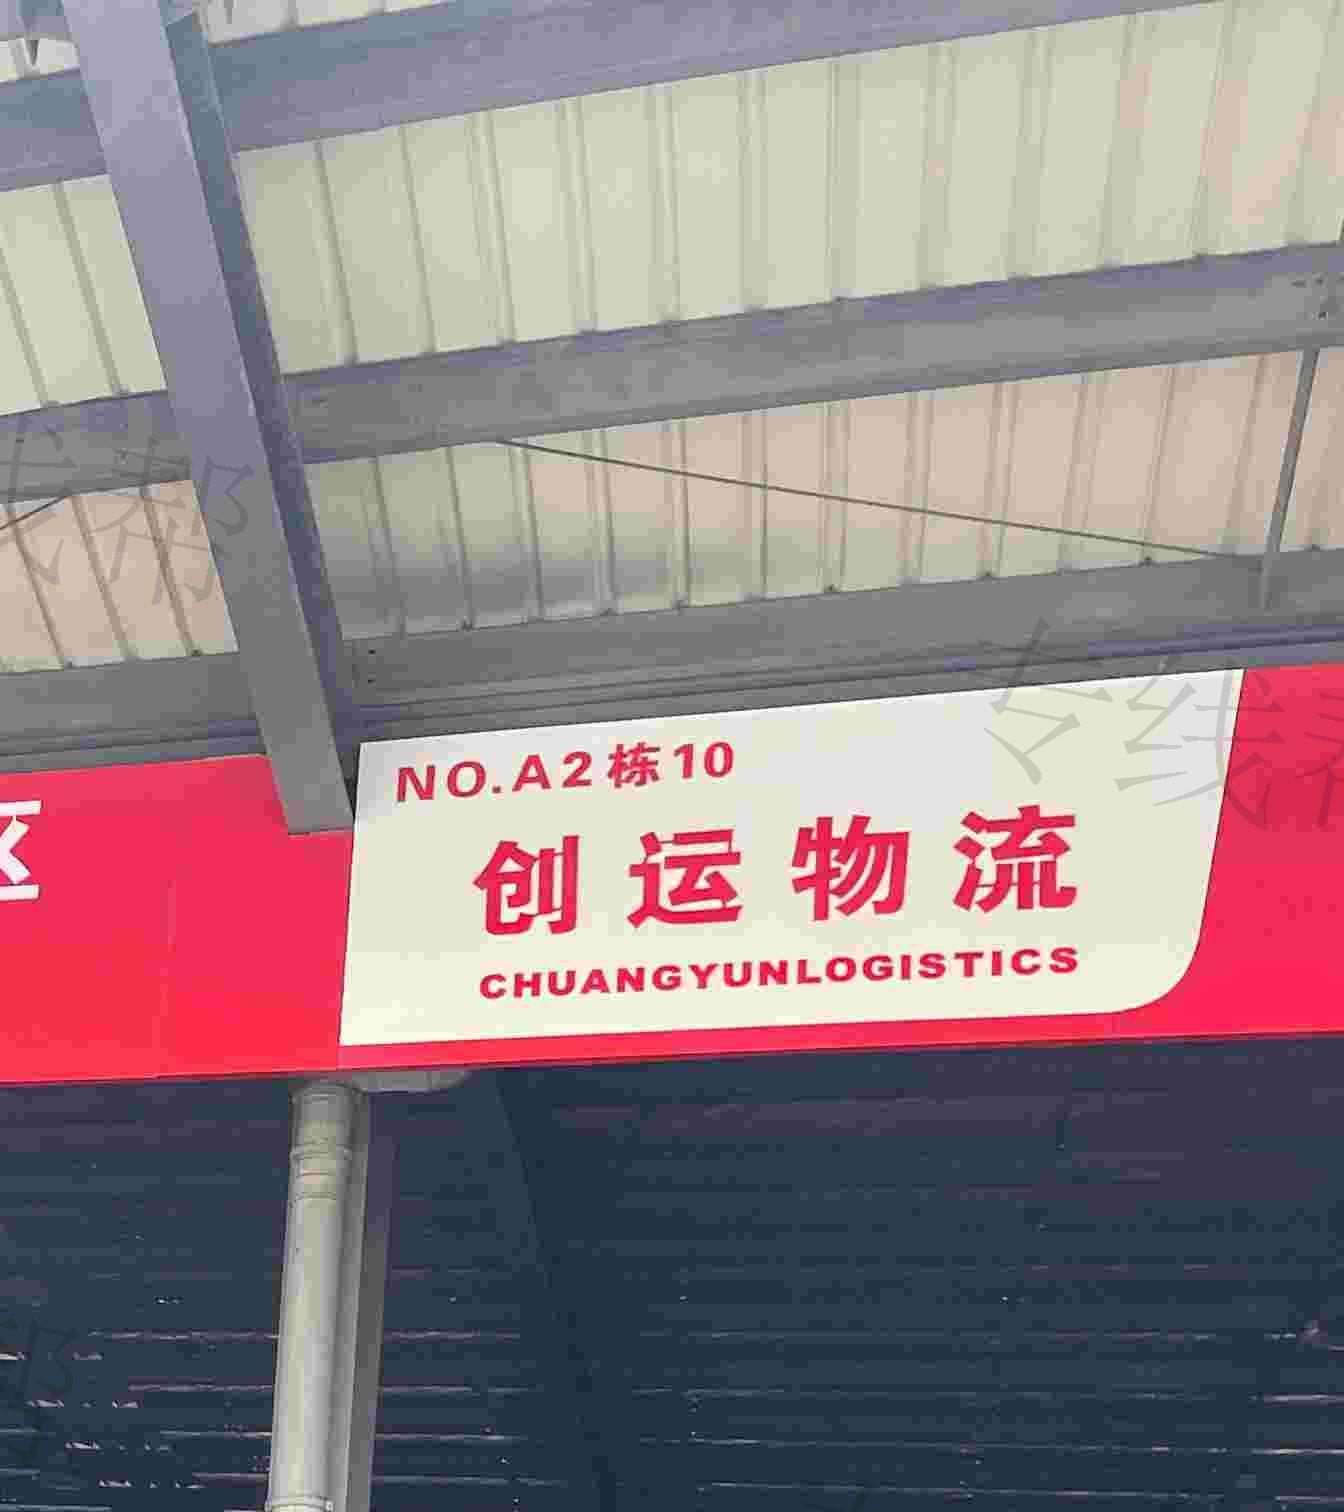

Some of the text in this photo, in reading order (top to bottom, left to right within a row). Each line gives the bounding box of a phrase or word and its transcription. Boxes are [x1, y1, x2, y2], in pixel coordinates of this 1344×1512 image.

[472, 803, 1079, 936] 创运物流
[479, 945, 1081, 1000] CHUANGYUNLOGISTICS
